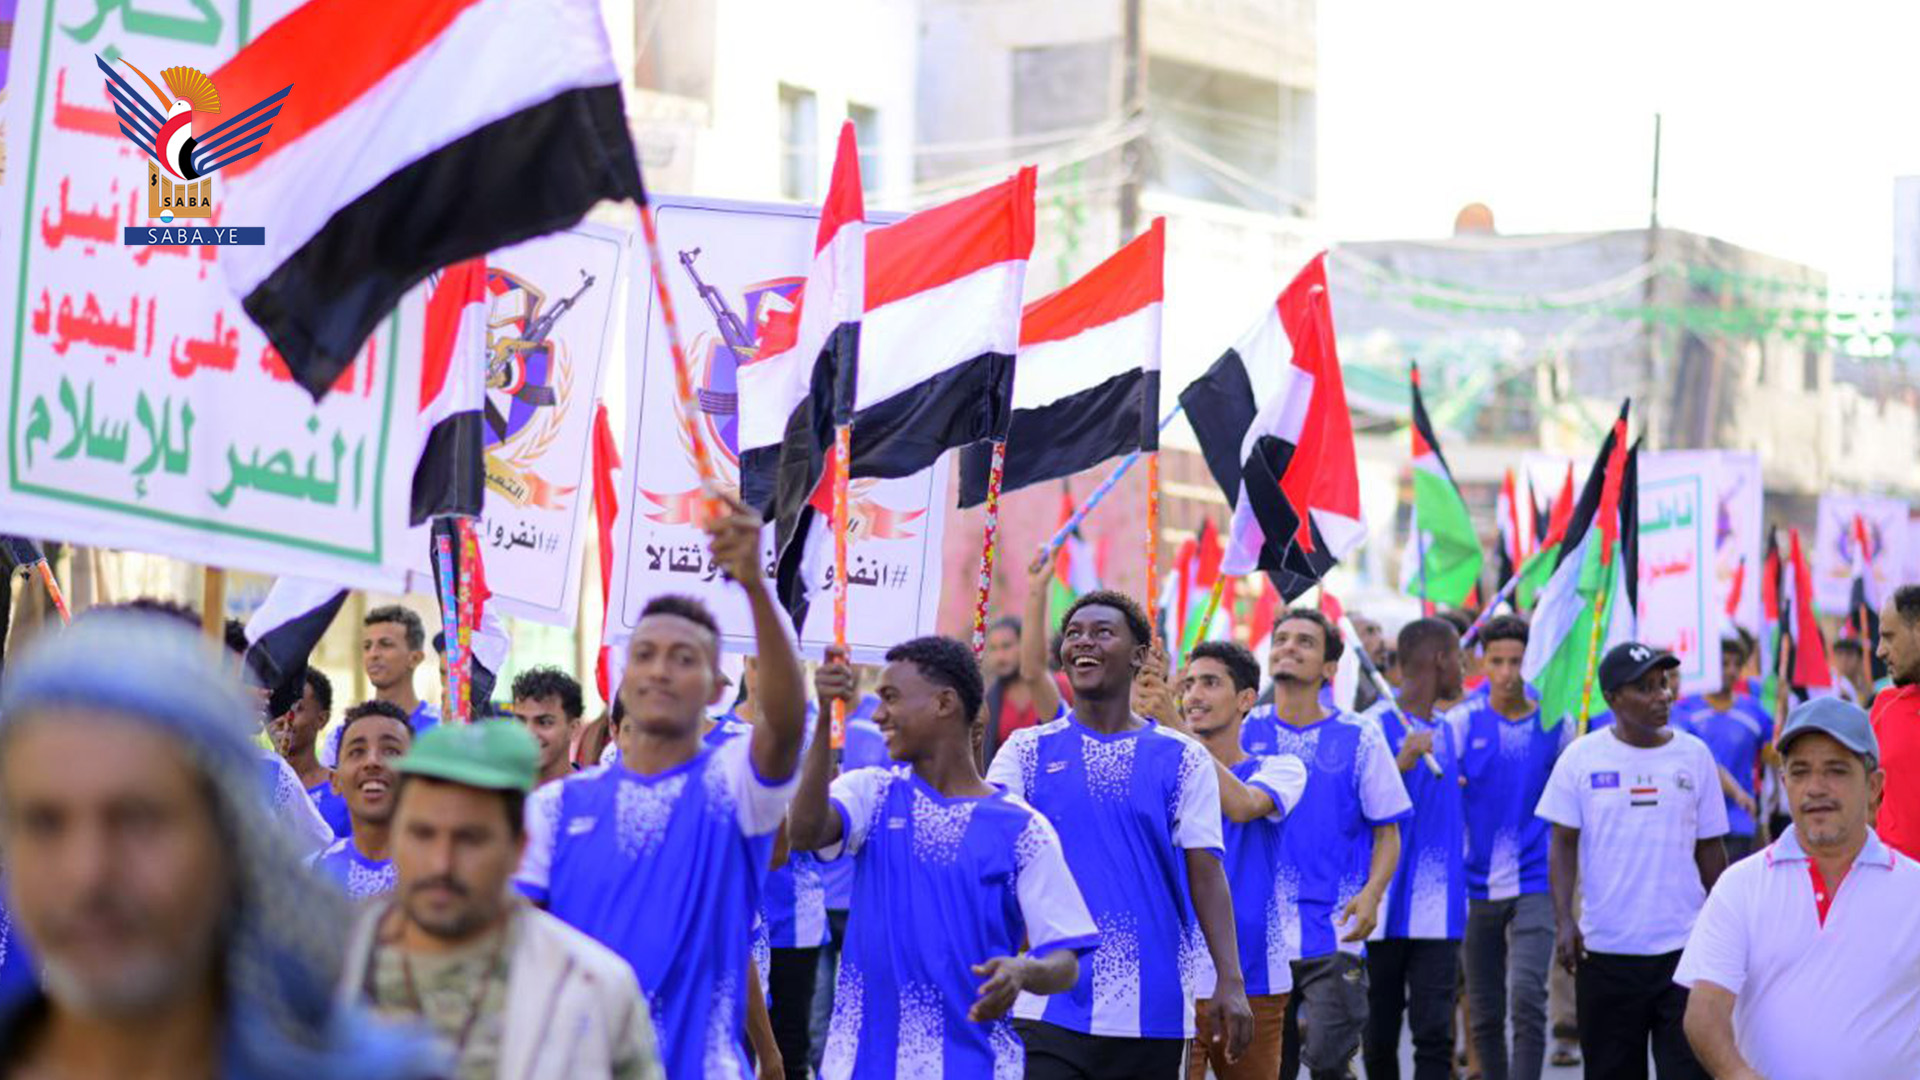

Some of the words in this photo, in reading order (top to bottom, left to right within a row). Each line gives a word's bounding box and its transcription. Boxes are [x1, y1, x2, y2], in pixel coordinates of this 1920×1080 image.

[32, 287, 155, 364] اليهود
[170, 309, 239, 379] على
[25, 373, 196, 501] للإسلام
[207, 409, 366, 511] النصر
